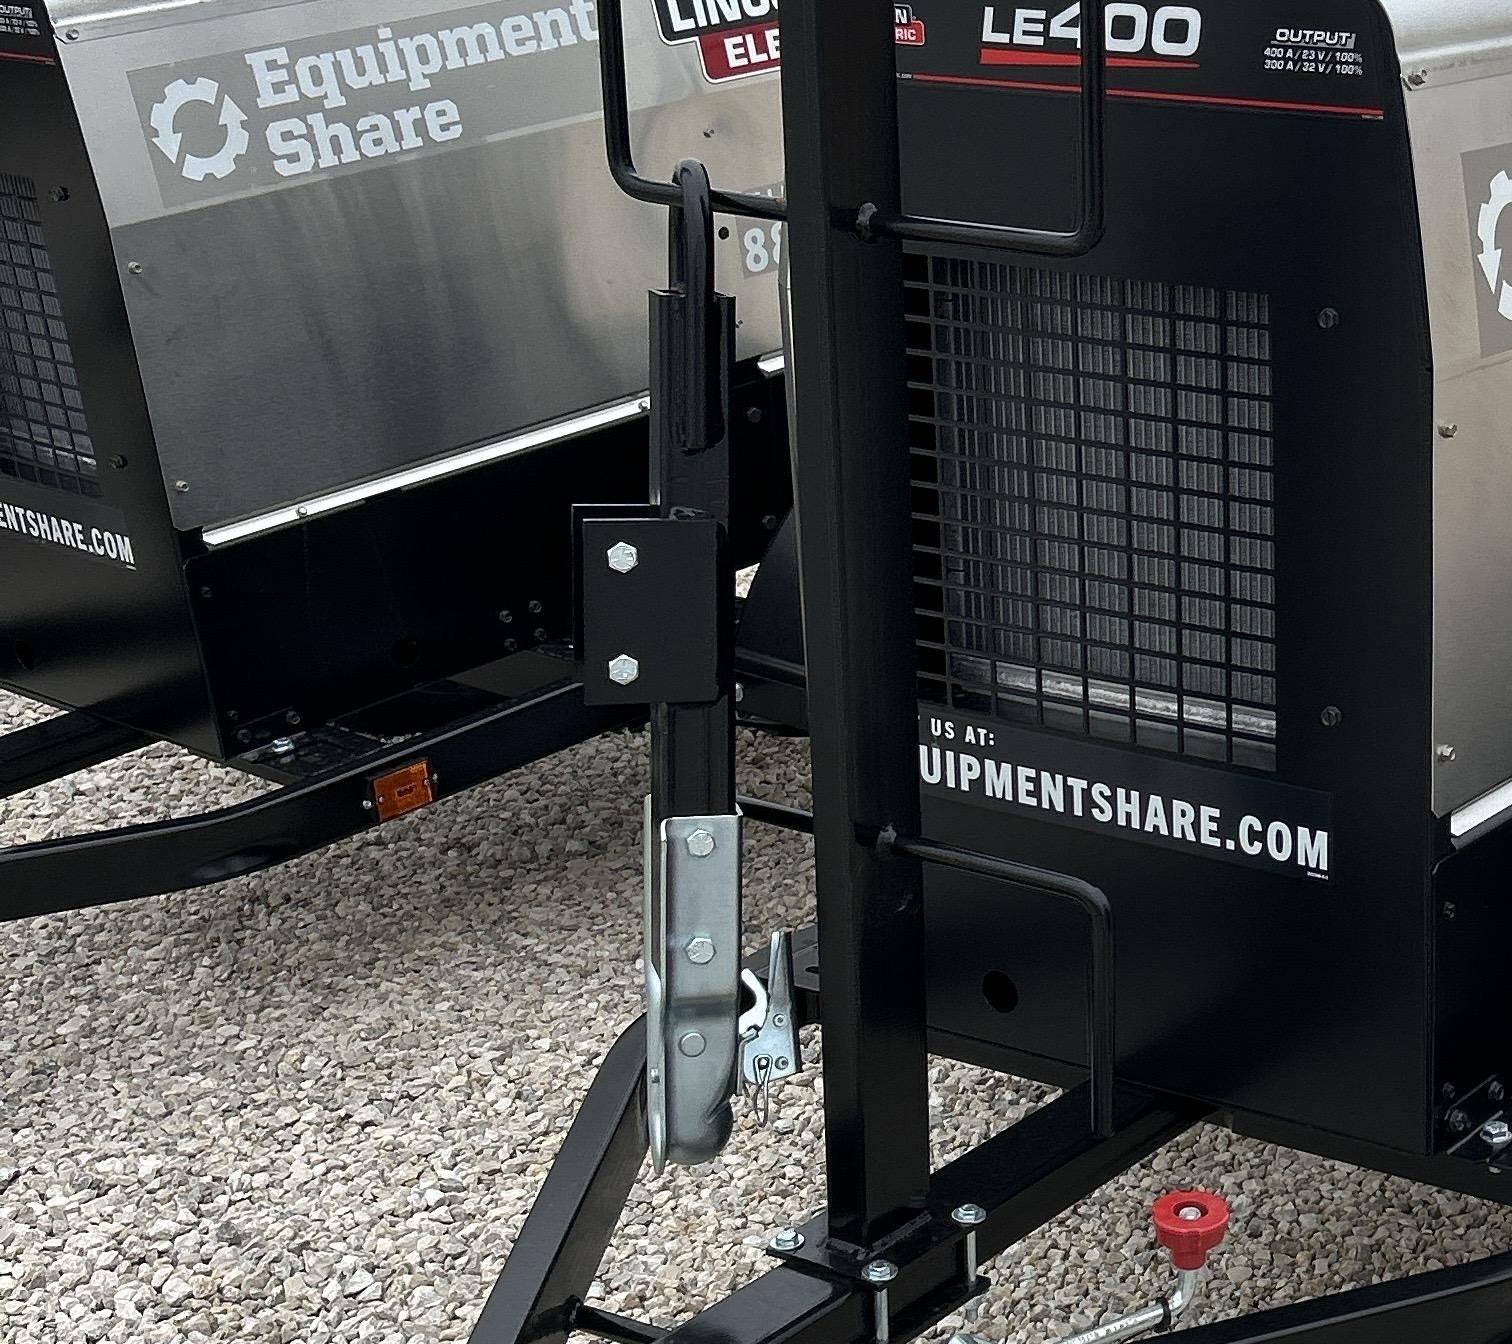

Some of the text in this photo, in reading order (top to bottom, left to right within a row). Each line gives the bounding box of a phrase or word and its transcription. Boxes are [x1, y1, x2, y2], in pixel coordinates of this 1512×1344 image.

[982, 1, 1202, 56] LE400
[1275, 28, 1351, 45] OUTPUT
[1264, 47, 1284, 58] 400
[265, 99, 464, 177] Share
[931, 717, 995, 747] US AT:
